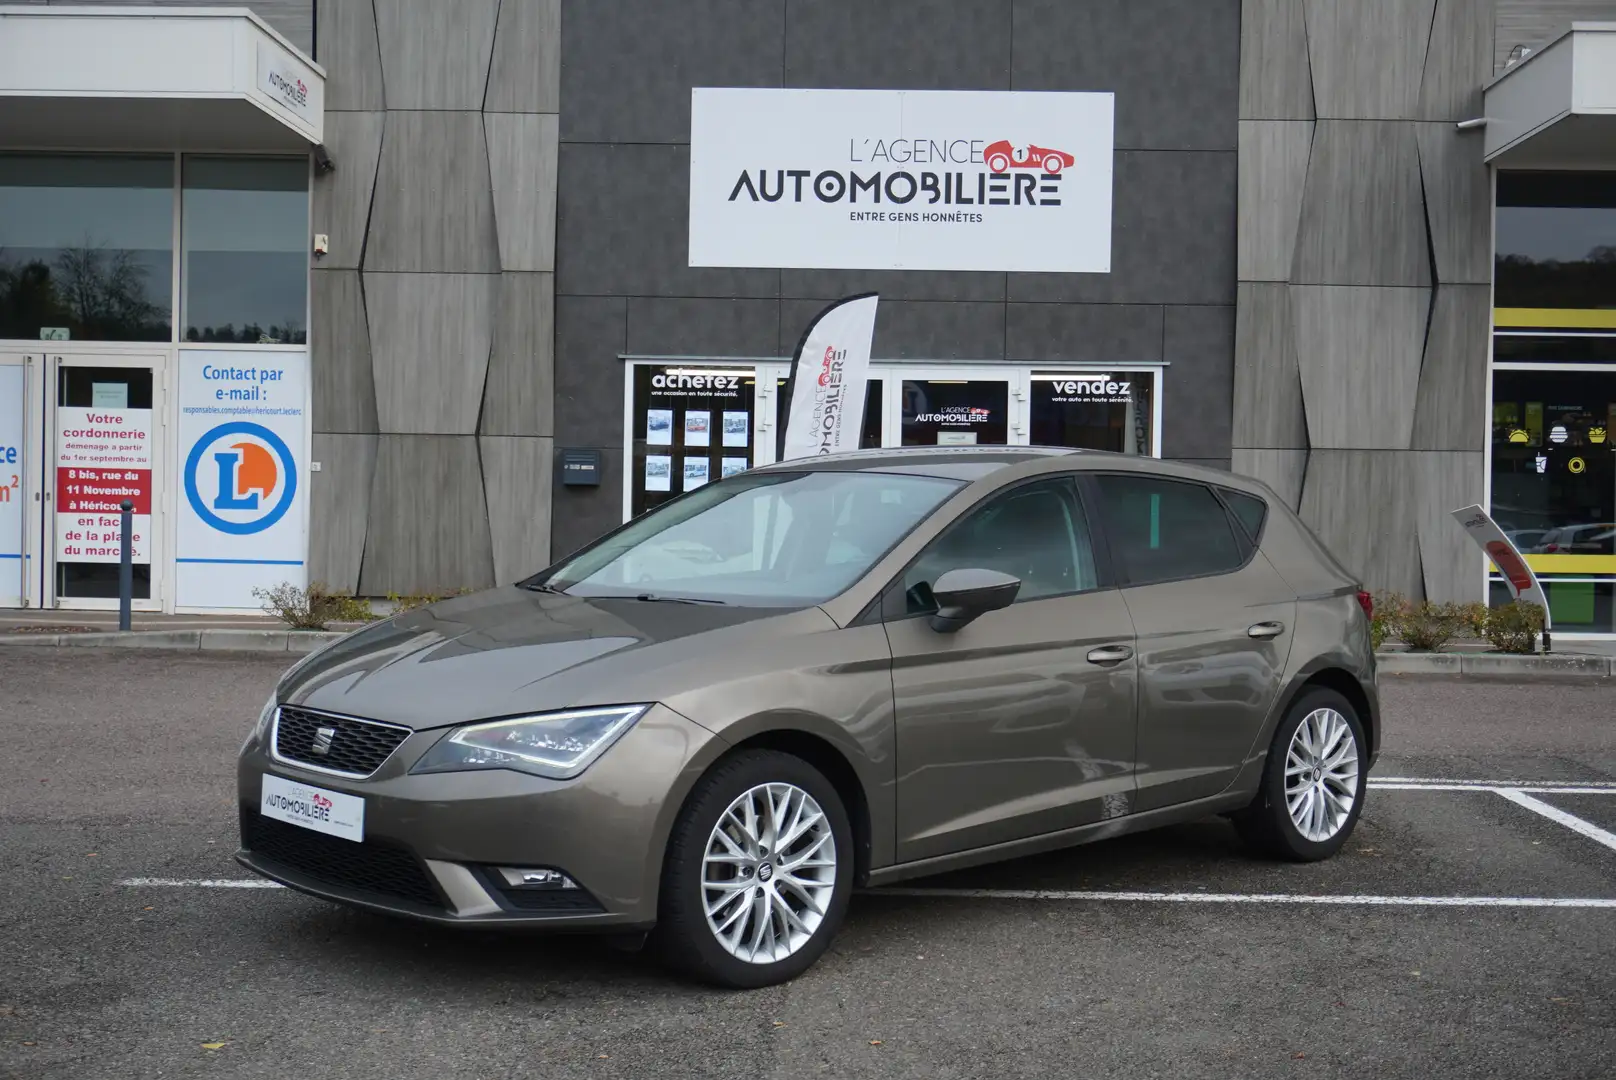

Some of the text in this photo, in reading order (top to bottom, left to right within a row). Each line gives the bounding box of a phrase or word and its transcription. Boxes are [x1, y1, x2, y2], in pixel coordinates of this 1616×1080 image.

[850, 138, 984, 164] L'AGENCE
[850, 211, 983, 223] ENTRE GENS HONNÊTES
[203, 365, 283, 384] Contact par
[652, 368, 739, 389] achetez
[1052, 374, 1131, 394] vendez
[216, 386, 259, 400] e-mail
[86, 413, 123, 424] Votre
[63, 428, 146, 439] cordonnerie
[89, 455, 134, 463] septembre
[68, 469, 139, 481] 8 bis, rue du
[66, 485, 141, 496] 11 Novembre
[69, 501, 76, 510] à
[78, 516, 121, 527] en fac
[65, 530, 141, 543] de la plae
[64, 545, 141, 556] du marcé.
